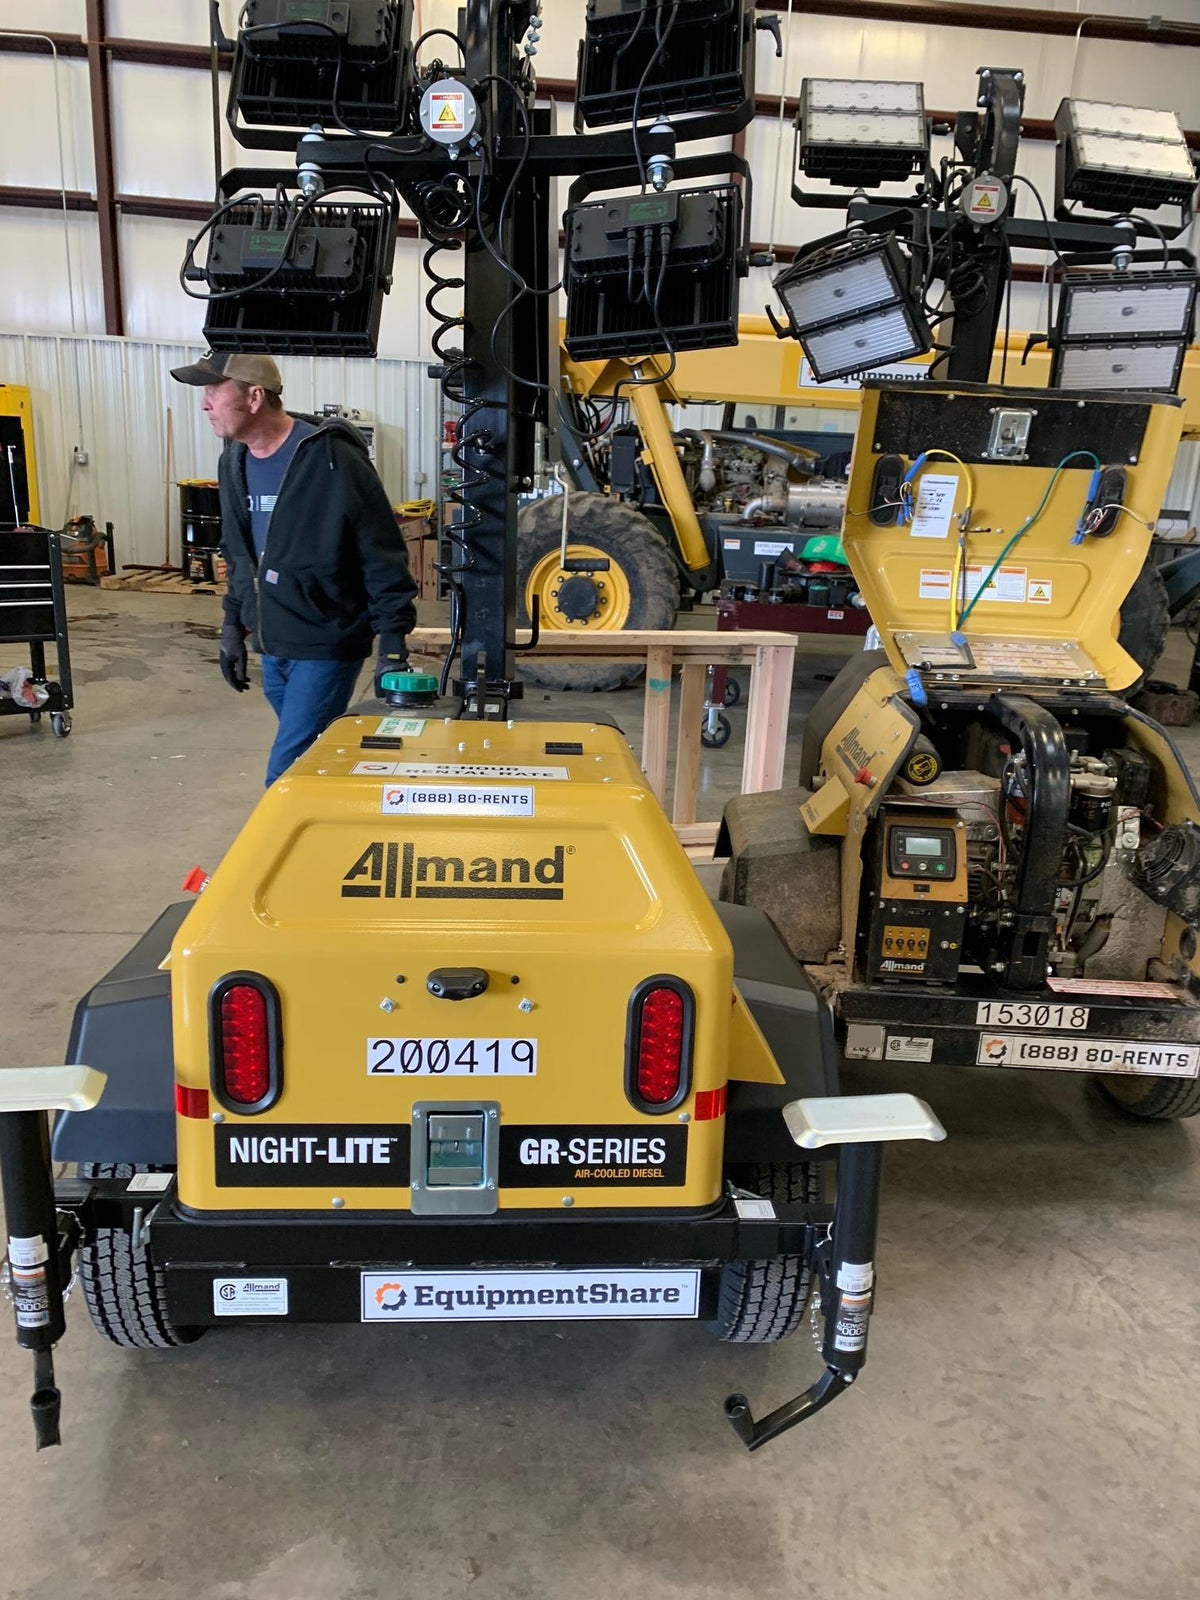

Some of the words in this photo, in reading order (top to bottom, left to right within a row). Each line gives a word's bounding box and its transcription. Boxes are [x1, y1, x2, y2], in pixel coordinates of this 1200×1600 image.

[411, 792, 452, 803] (888)
[457, 793, 529, 805] 80-RENTS
[341, 842, 564, 900] Allmand
[879, 960, 925, 973] Allmand
[980, 1003, 1086, 1027] 153018
[371, 1039, 536, 1074] 200419
[1020, 1042, 1078, 1062] (888)
[1086, 1048, 1190, 1068] 80-RENTS
[519, 1137, 667, 1165] GR-SERIES
[574, 1168, 630, 1179] AIR-COOLED
[632, 1168, 665, 1179] DIESEL
[243, 1283, 281, 1292] Allmand
[414, 1283, 680, 1311] EquipmentShare
